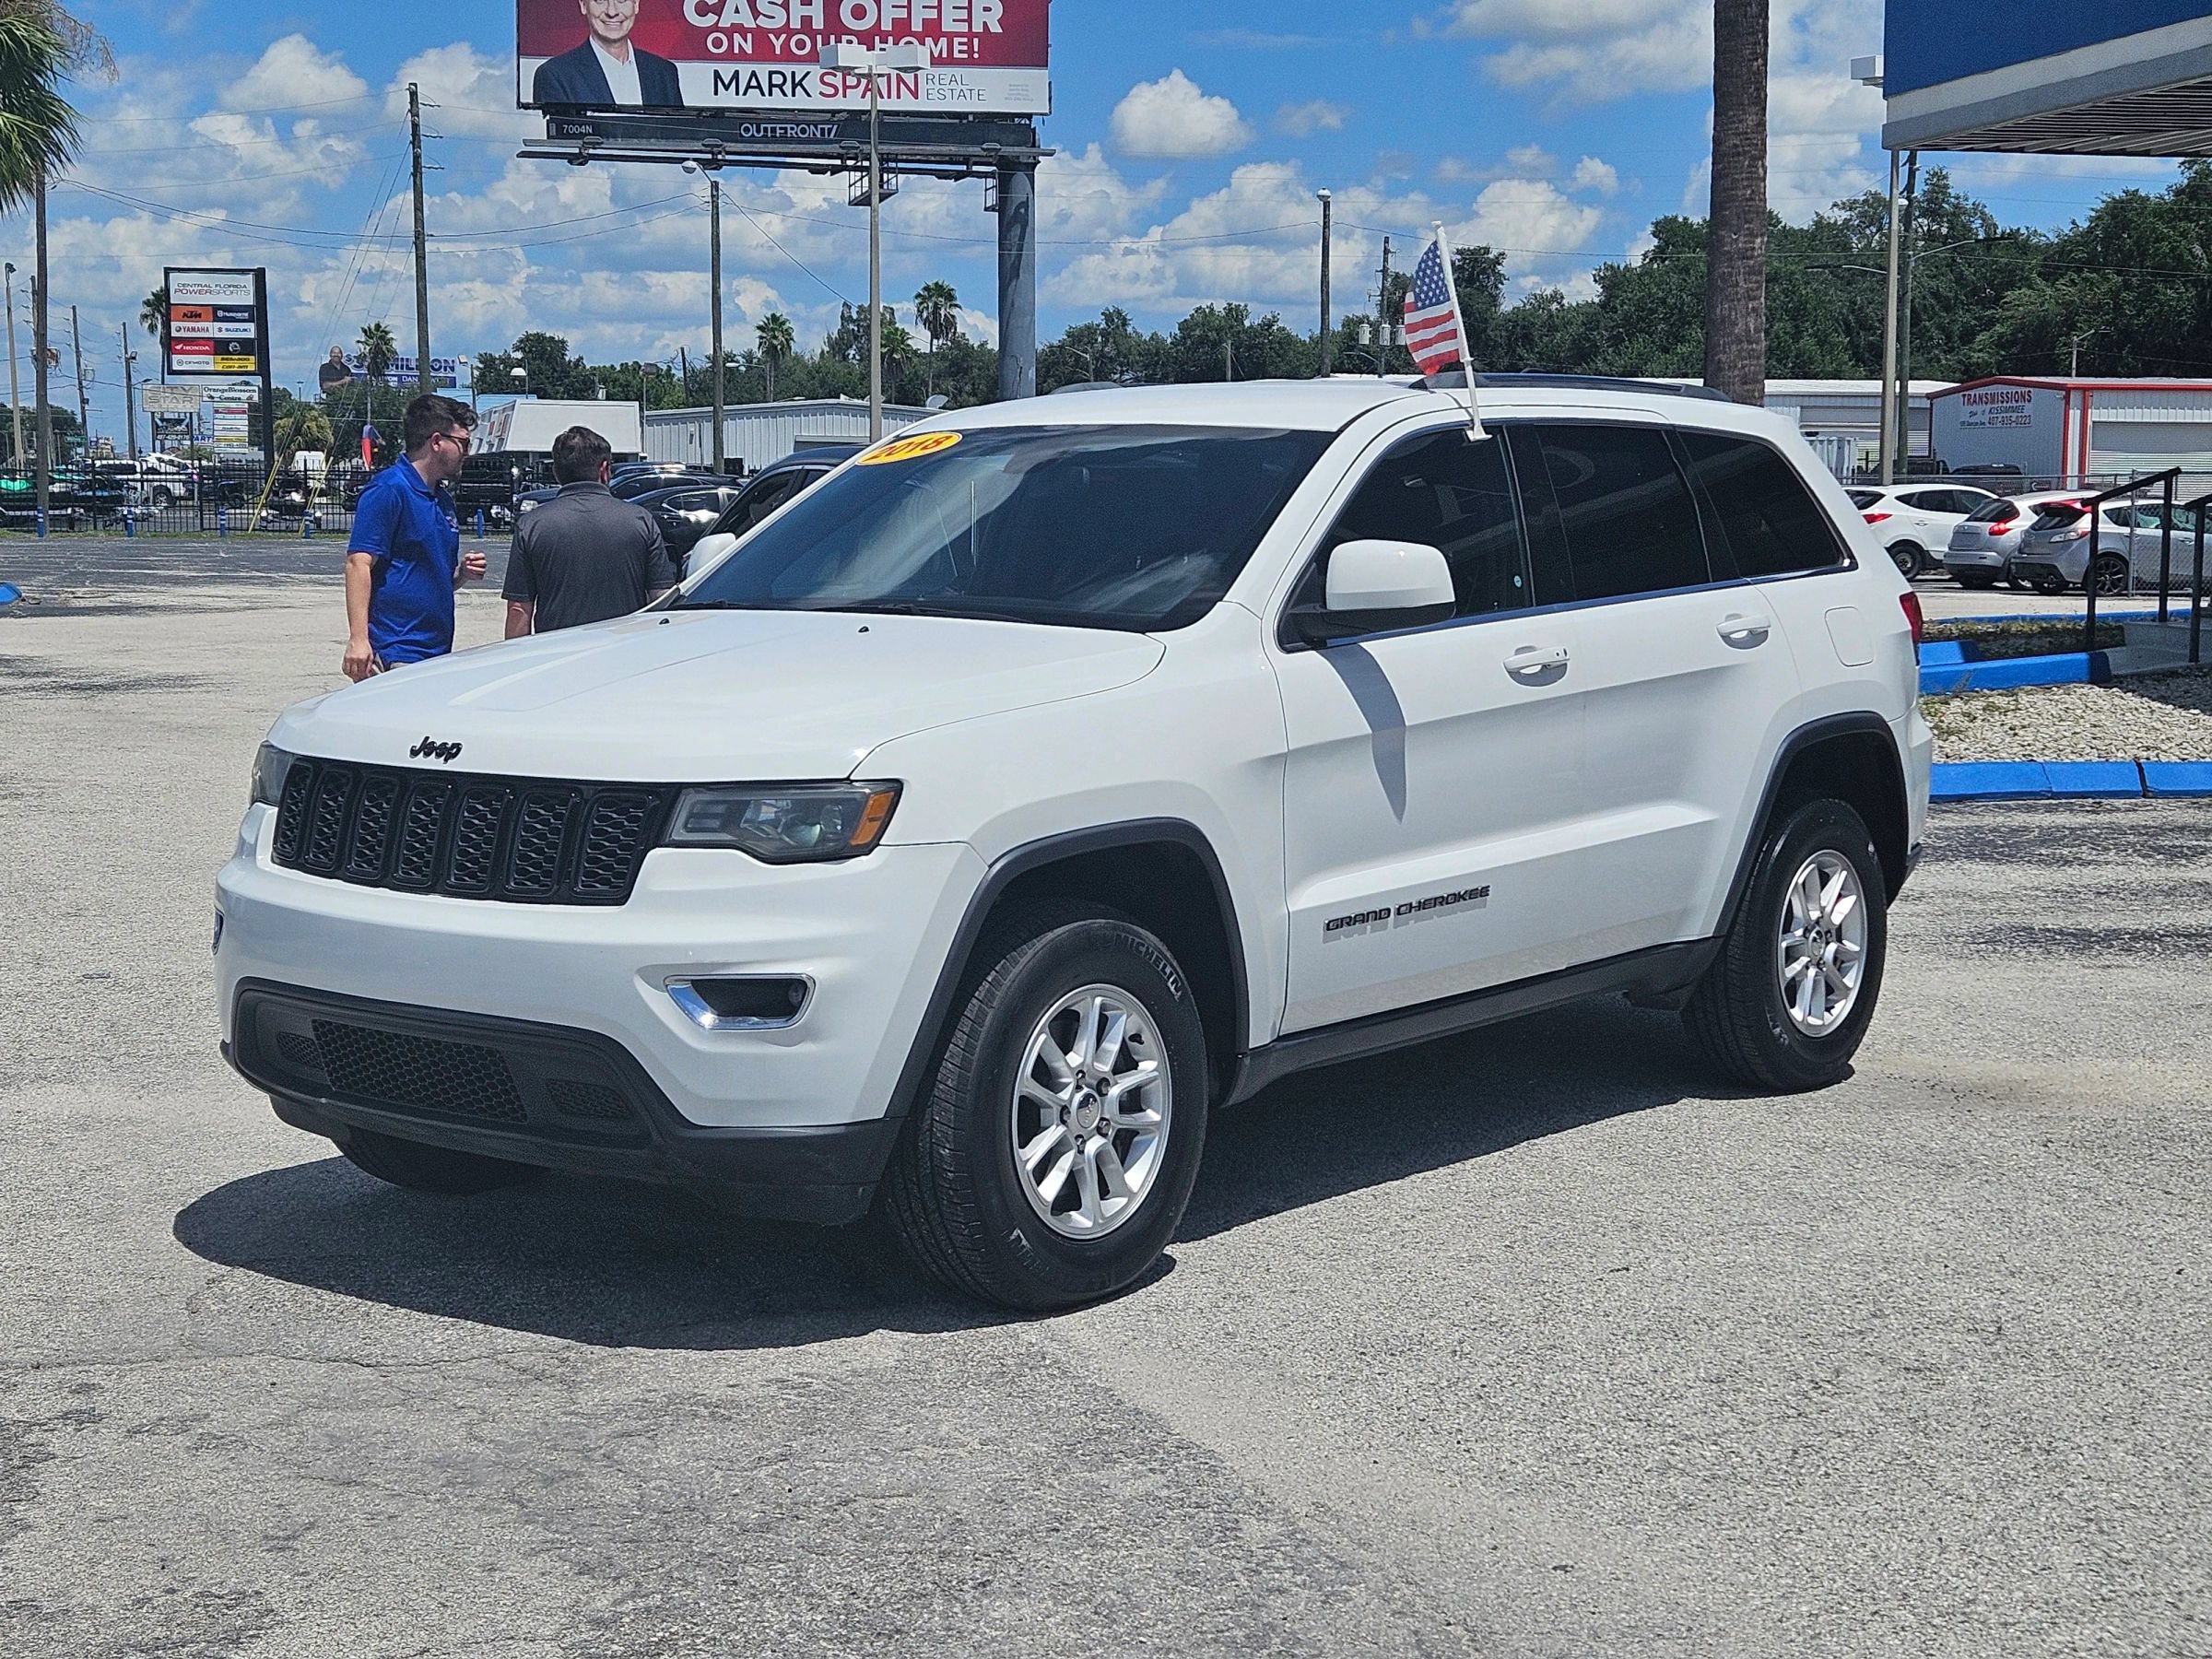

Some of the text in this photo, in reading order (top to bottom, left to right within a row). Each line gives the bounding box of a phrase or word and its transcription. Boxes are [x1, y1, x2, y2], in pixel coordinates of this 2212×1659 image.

[683, 0, 1004, 33] CASH OFFER
[706, 32, 753, 54] ON
[712, 69, 920, 100] MARK SPAIN
[925, 74, 970, 87] REAL
[926, 88, 987, 101] ESTATE
[562, 124, 593, 135] 7004N
[182, 310, 202, 319] KTM
[384, 357, 456, 372] MILLON
[148, 395, 194, 405] STAR
[1961, 390, 2032, 406] TRANSMISSIONS
[1988, 406, 2026, 415] KISSIMMEE
[1988, 415, 2031, 426] 407-935-0223
[862, 435, 953, 463] 2018
[409, 735, 463, 764] Jeep
[1325, 885, 1490, 932] GRAND CHEROKEE
[1112, 931, 1182, 1002] MICHELIN
